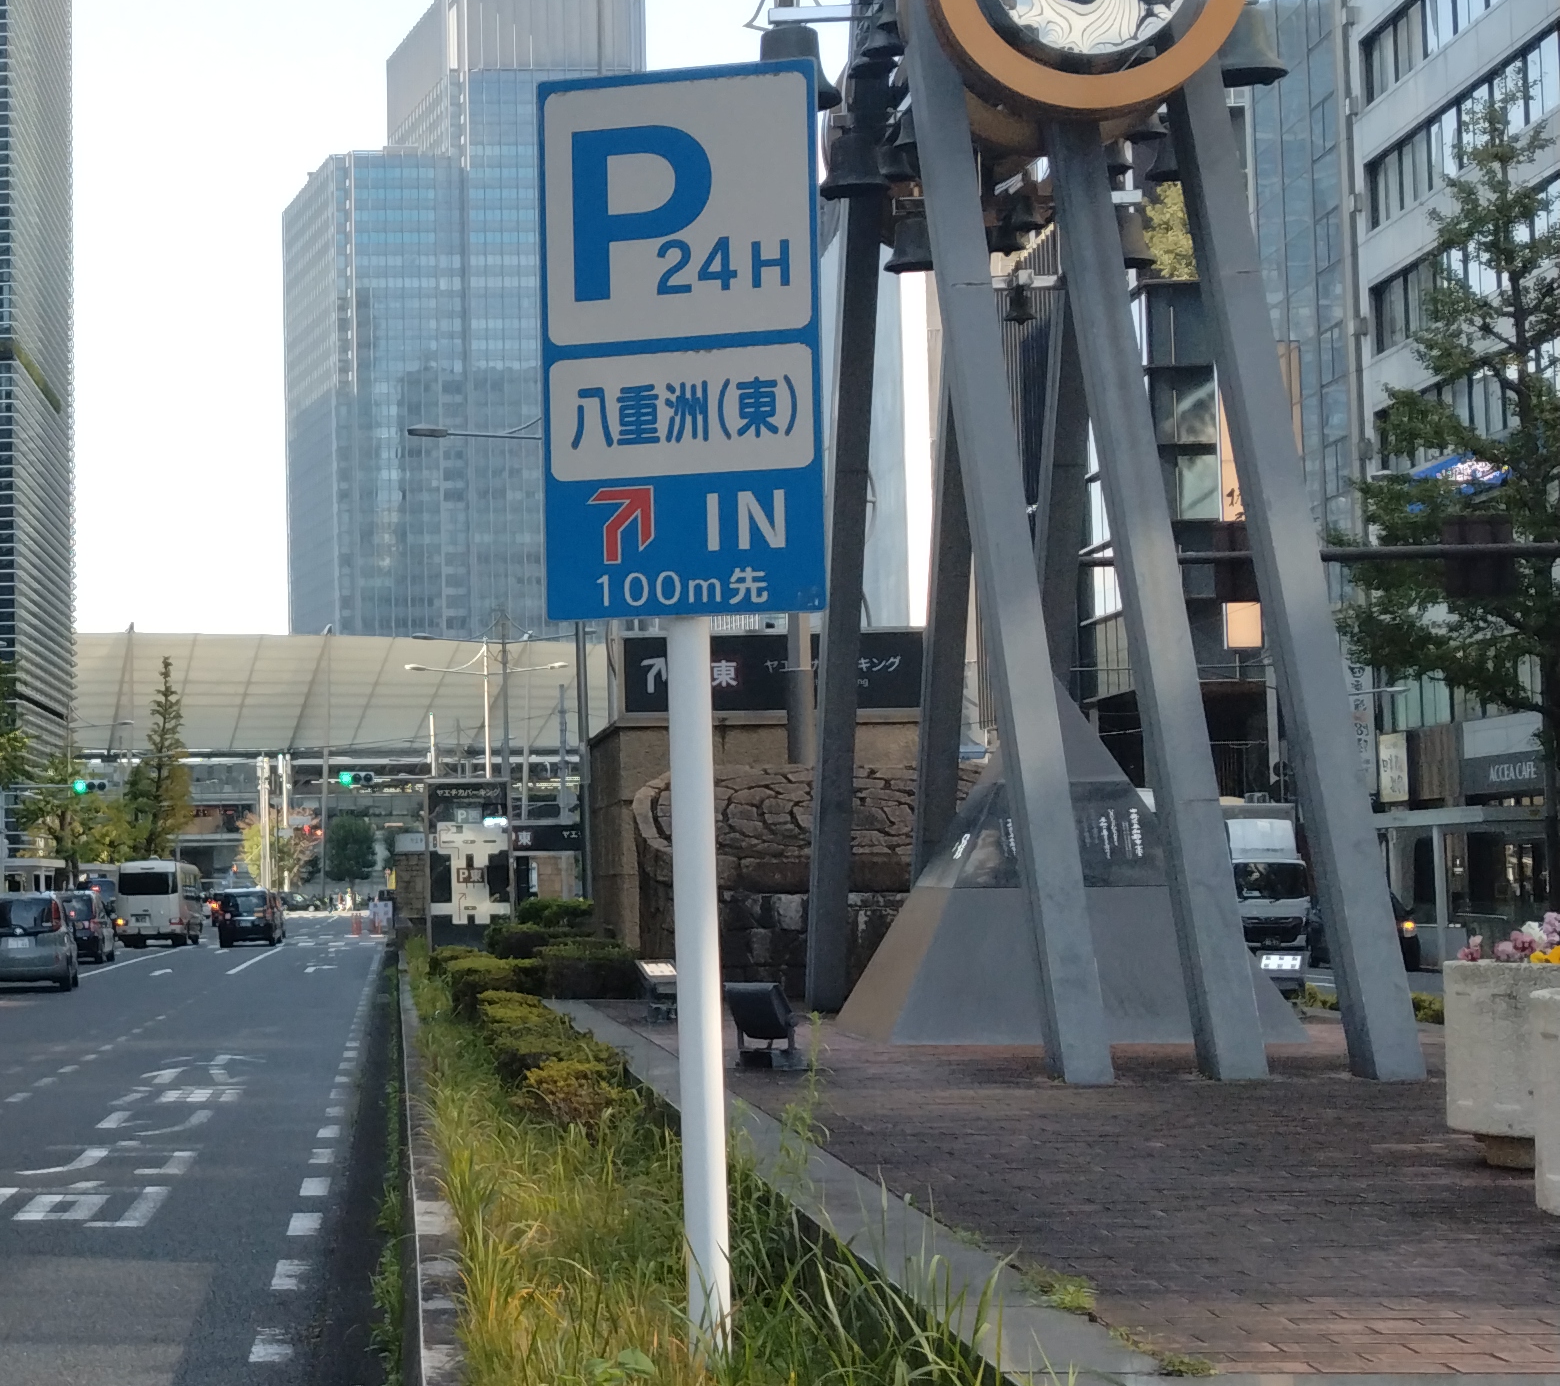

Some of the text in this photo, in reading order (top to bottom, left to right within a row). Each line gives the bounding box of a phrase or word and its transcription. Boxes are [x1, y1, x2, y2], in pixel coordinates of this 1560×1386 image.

[571, 124, 712, 303] P
[655, 235, 791, 296] 24H
[571, 374, 798, 450] 八重洲(東)
[705, 489, 787, 551] IN
[596, 566, 769, 608] 100m先
[710, 659, 738, 687] 東
[1489, 763, 1514, 783] ACCEA
[457, 809, 467, 823] P
[459, 869, 469, 882] P
